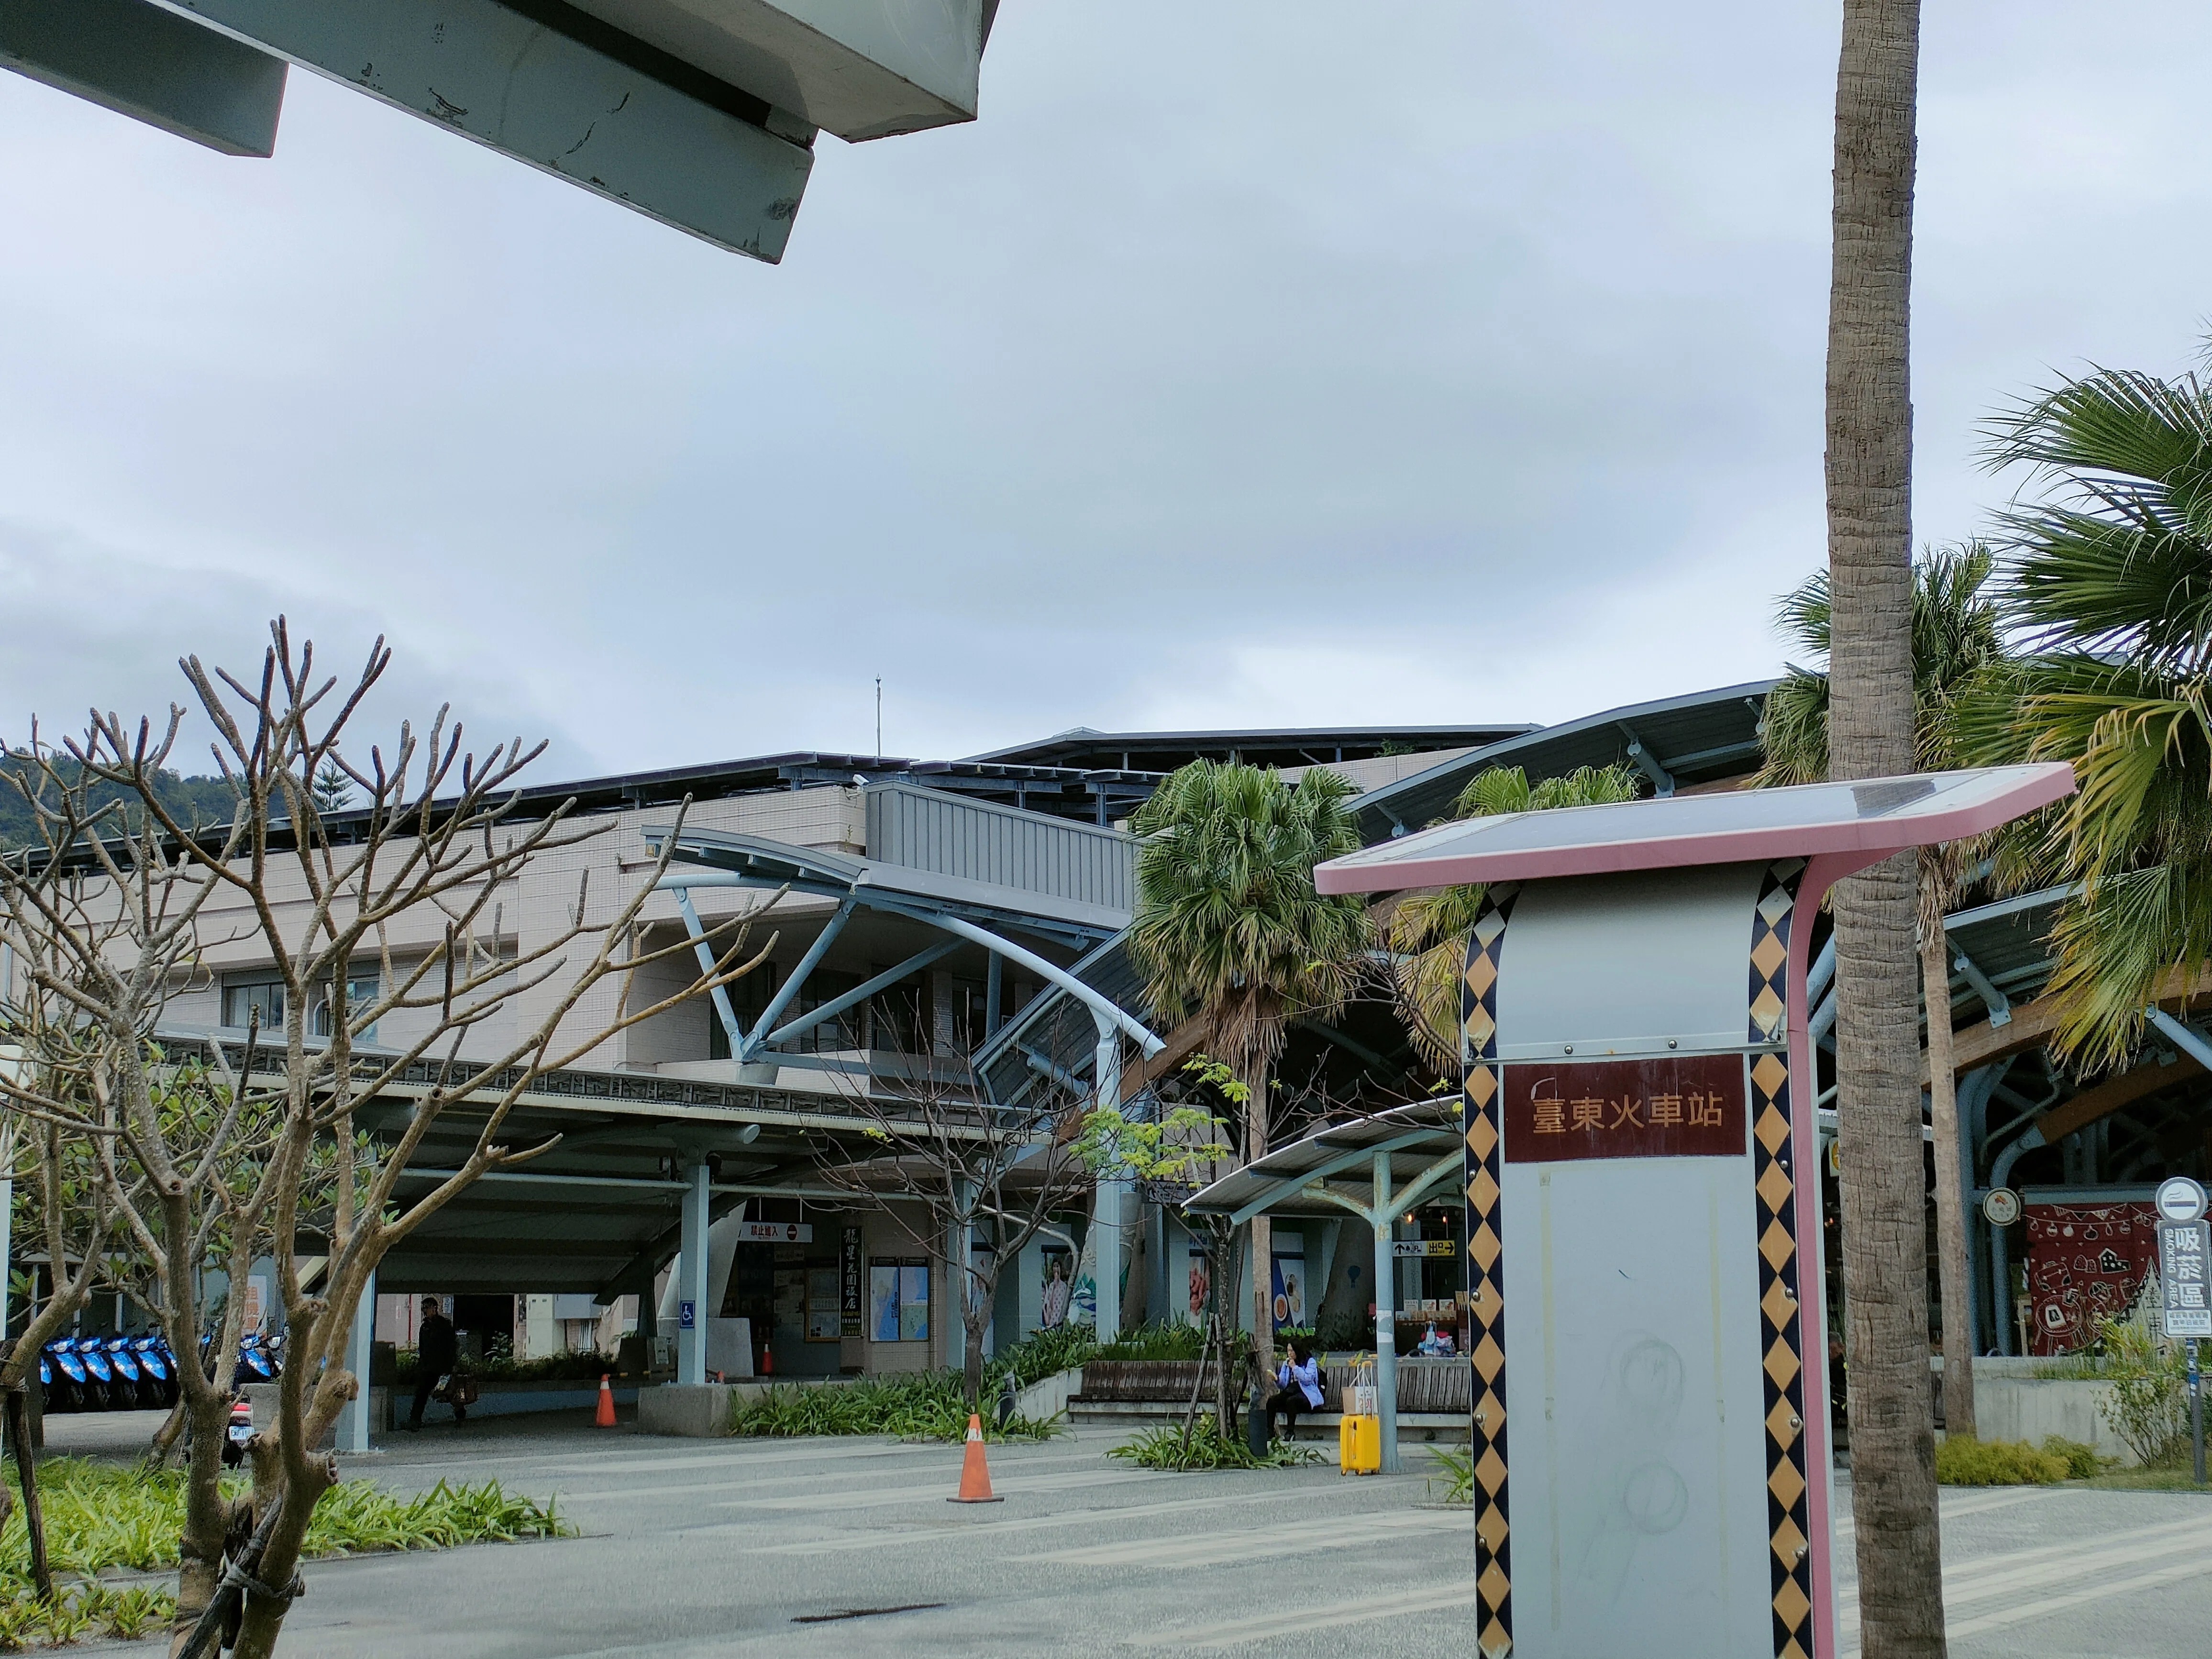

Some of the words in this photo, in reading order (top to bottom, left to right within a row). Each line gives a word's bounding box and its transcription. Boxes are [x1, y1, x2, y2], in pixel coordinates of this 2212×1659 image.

[1533, 1091, 1724, 1134] 臺東火車站
[1429, 1242, 1444, 1253] 出口
[2164, 1228, 2177, 1273] SMOKING
[2175, 1227, 2206, 1307] 吸菸區
[2168, 1278, 2179, 1308] AREA
